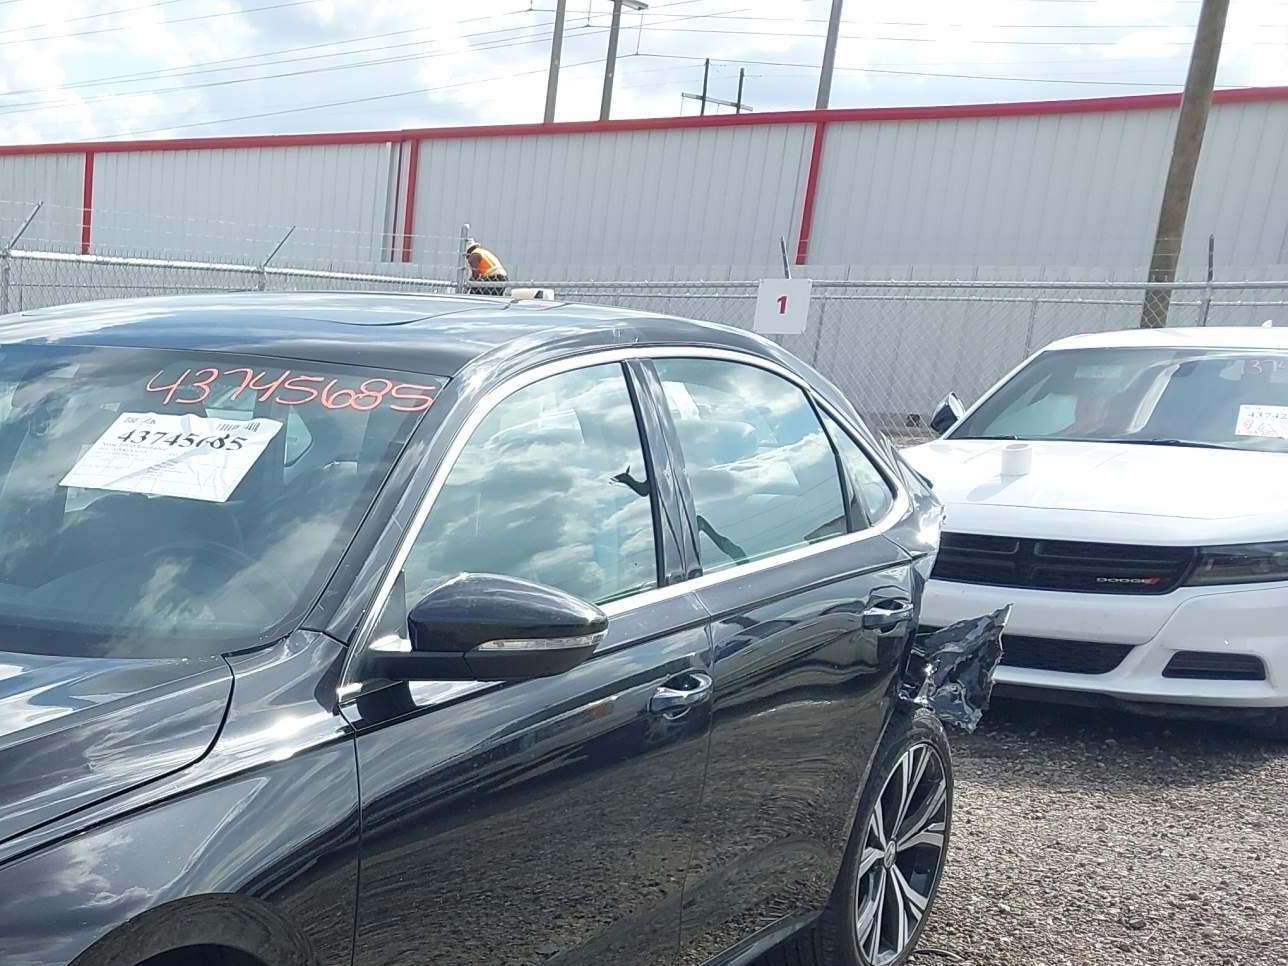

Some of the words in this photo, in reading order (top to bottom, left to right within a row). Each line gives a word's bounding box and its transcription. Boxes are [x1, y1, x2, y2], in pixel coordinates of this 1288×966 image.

[776, 295, 788, 315] 1
[145, 367, 436, 412] 43745685
[1096, 577, 1150, 585] DODGE
